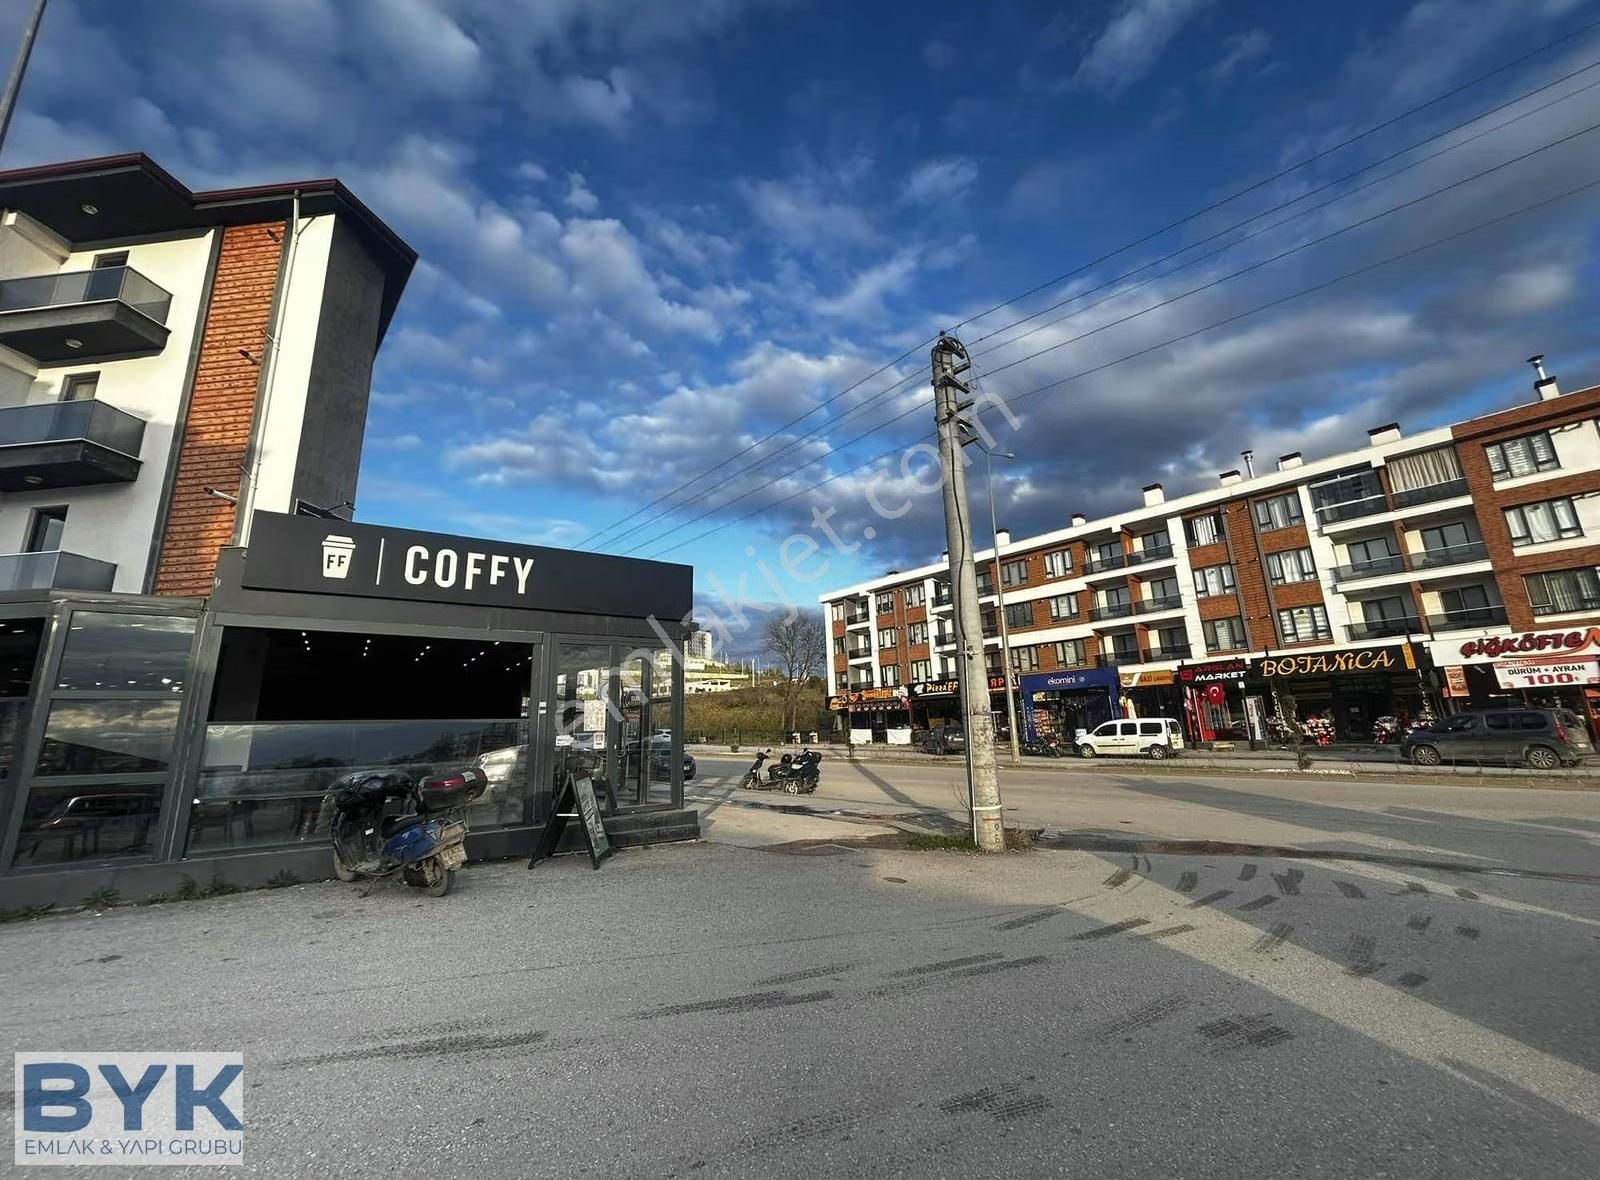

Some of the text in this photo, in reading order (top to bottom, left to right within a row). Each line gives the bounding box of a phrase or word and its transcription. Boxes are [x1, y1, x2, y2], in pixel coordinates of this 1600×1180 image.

[403, 544, 534, 594] COFFY
[1194, 670, 1247, 682] MARKET
[1507, 667, 1542, 676] DÜRÜM
[1552, 664, 1586, 673] AYRAN
[1047, 674, 1076, 686] ekomini
